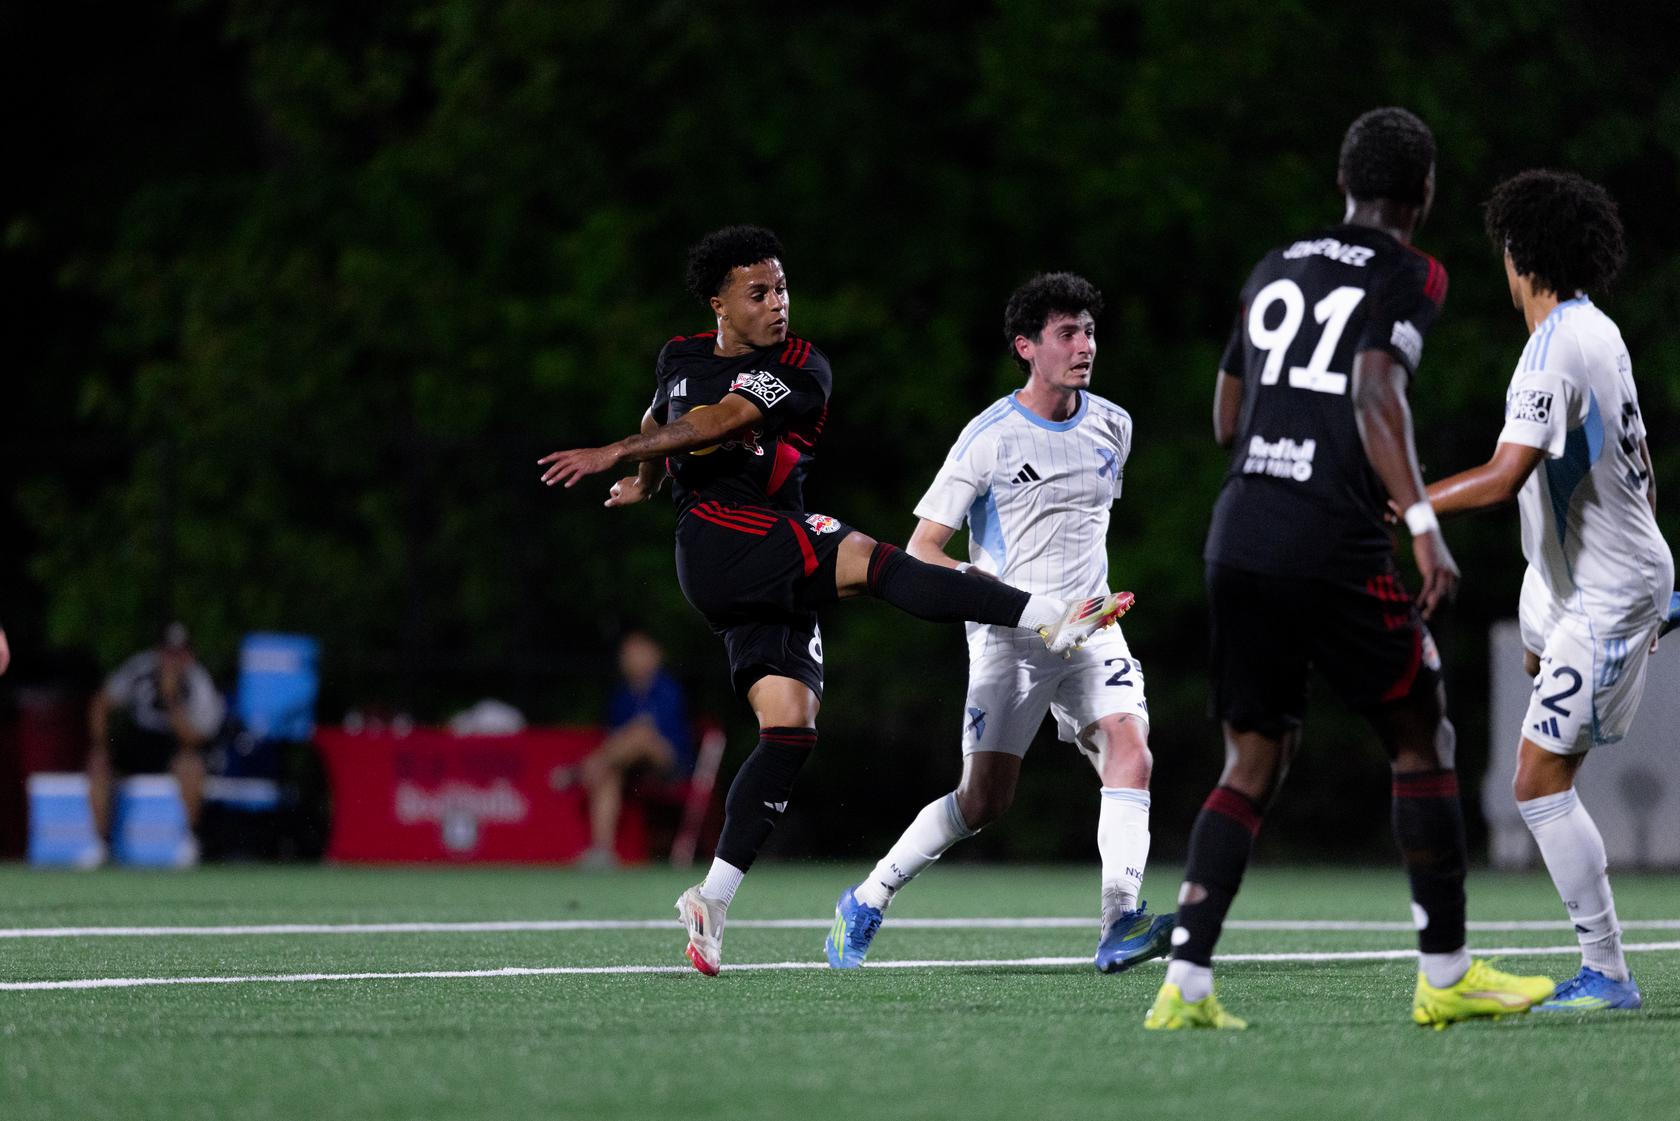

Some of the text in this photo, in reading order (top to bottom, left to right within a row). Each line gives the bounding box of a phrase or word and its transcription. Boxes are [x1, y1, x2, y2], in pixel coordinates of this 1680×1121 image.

[1248, 278, 1366, 395] 91
[751, 381, 776, 401] PRO
[753, 371, 786, 394] NEXT
